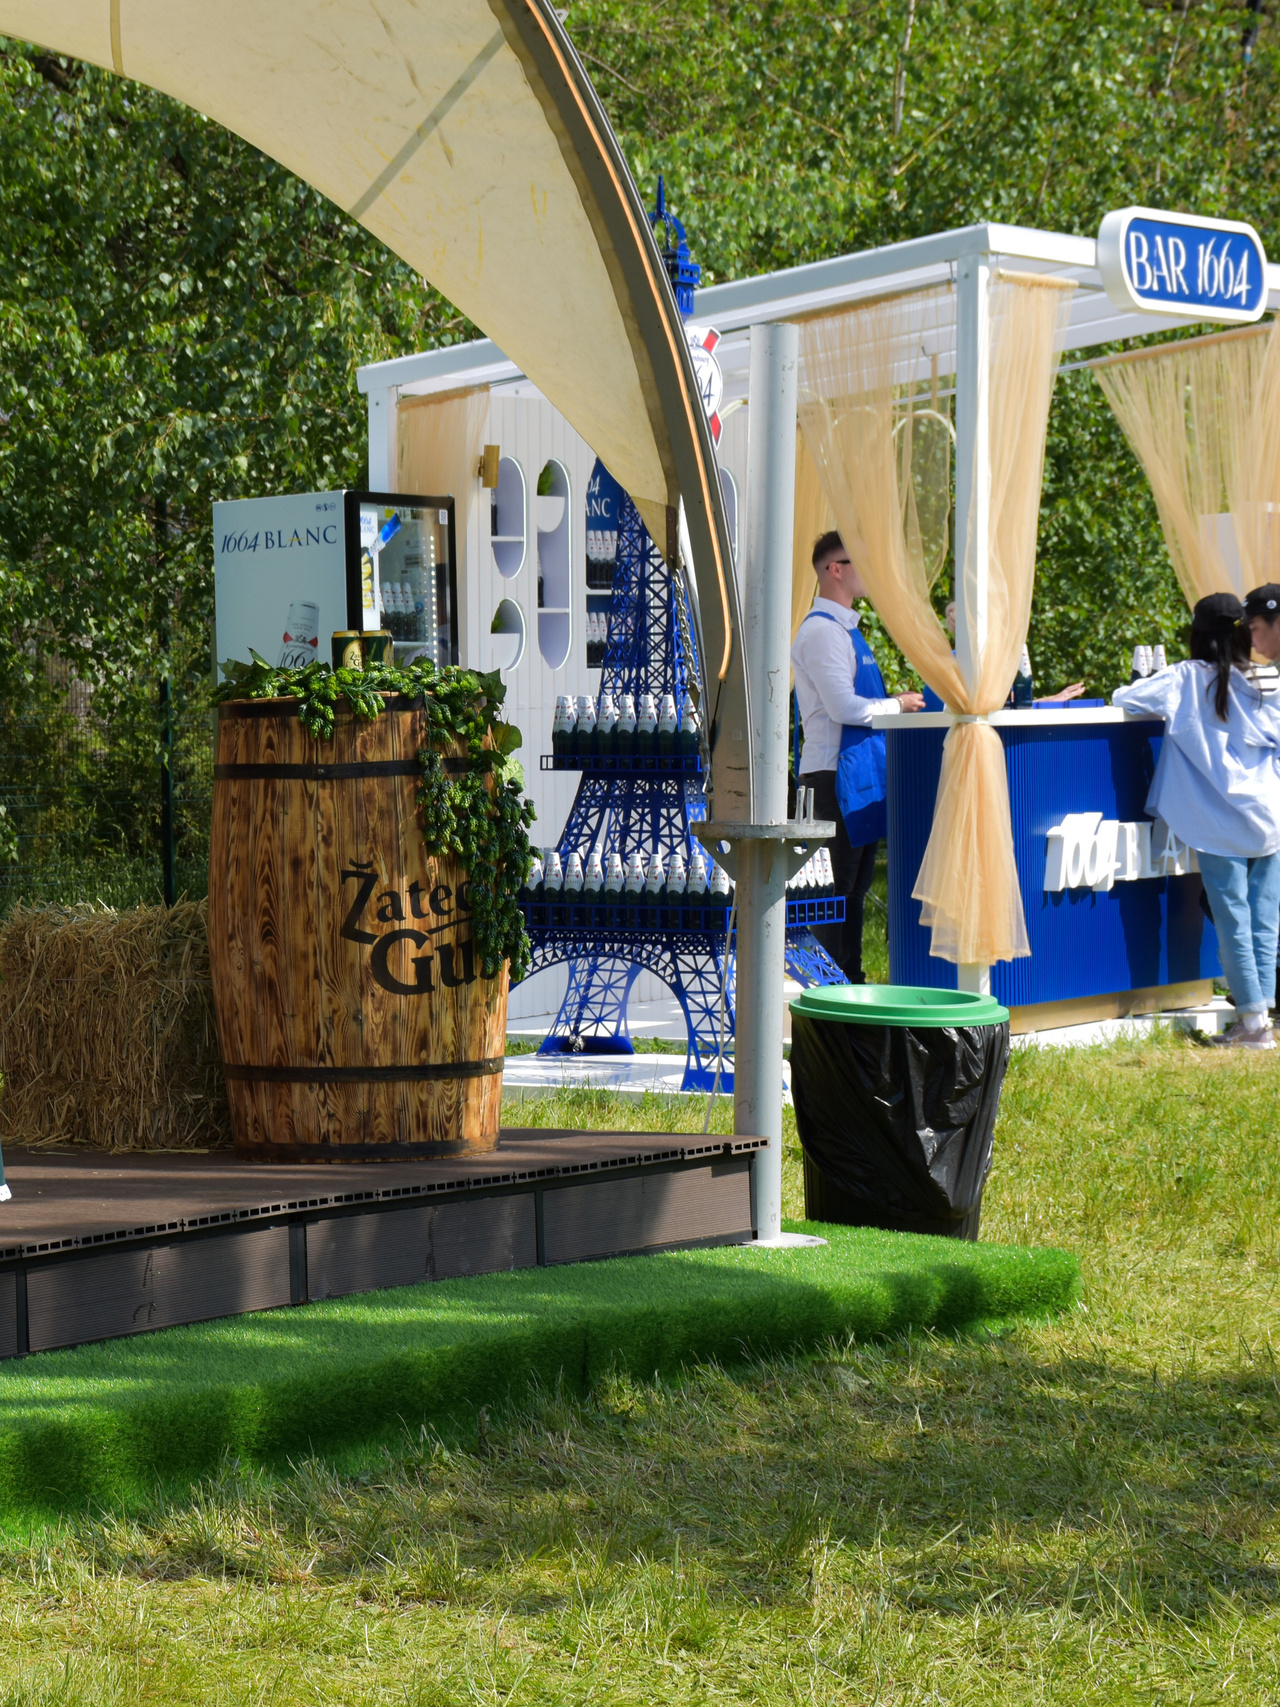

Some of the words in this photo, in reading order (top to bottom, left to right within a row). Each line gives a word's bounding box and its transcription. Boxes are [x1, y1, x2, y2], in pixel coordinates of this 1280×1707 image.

[1129, 231, 1190, 295] BAR
[1197, 236, 1252, 306] 1664
[221, 529, 260, 554] 1664
[265, 525, 337, 550] BLANC
[371, 928, 497, 996] Gu
